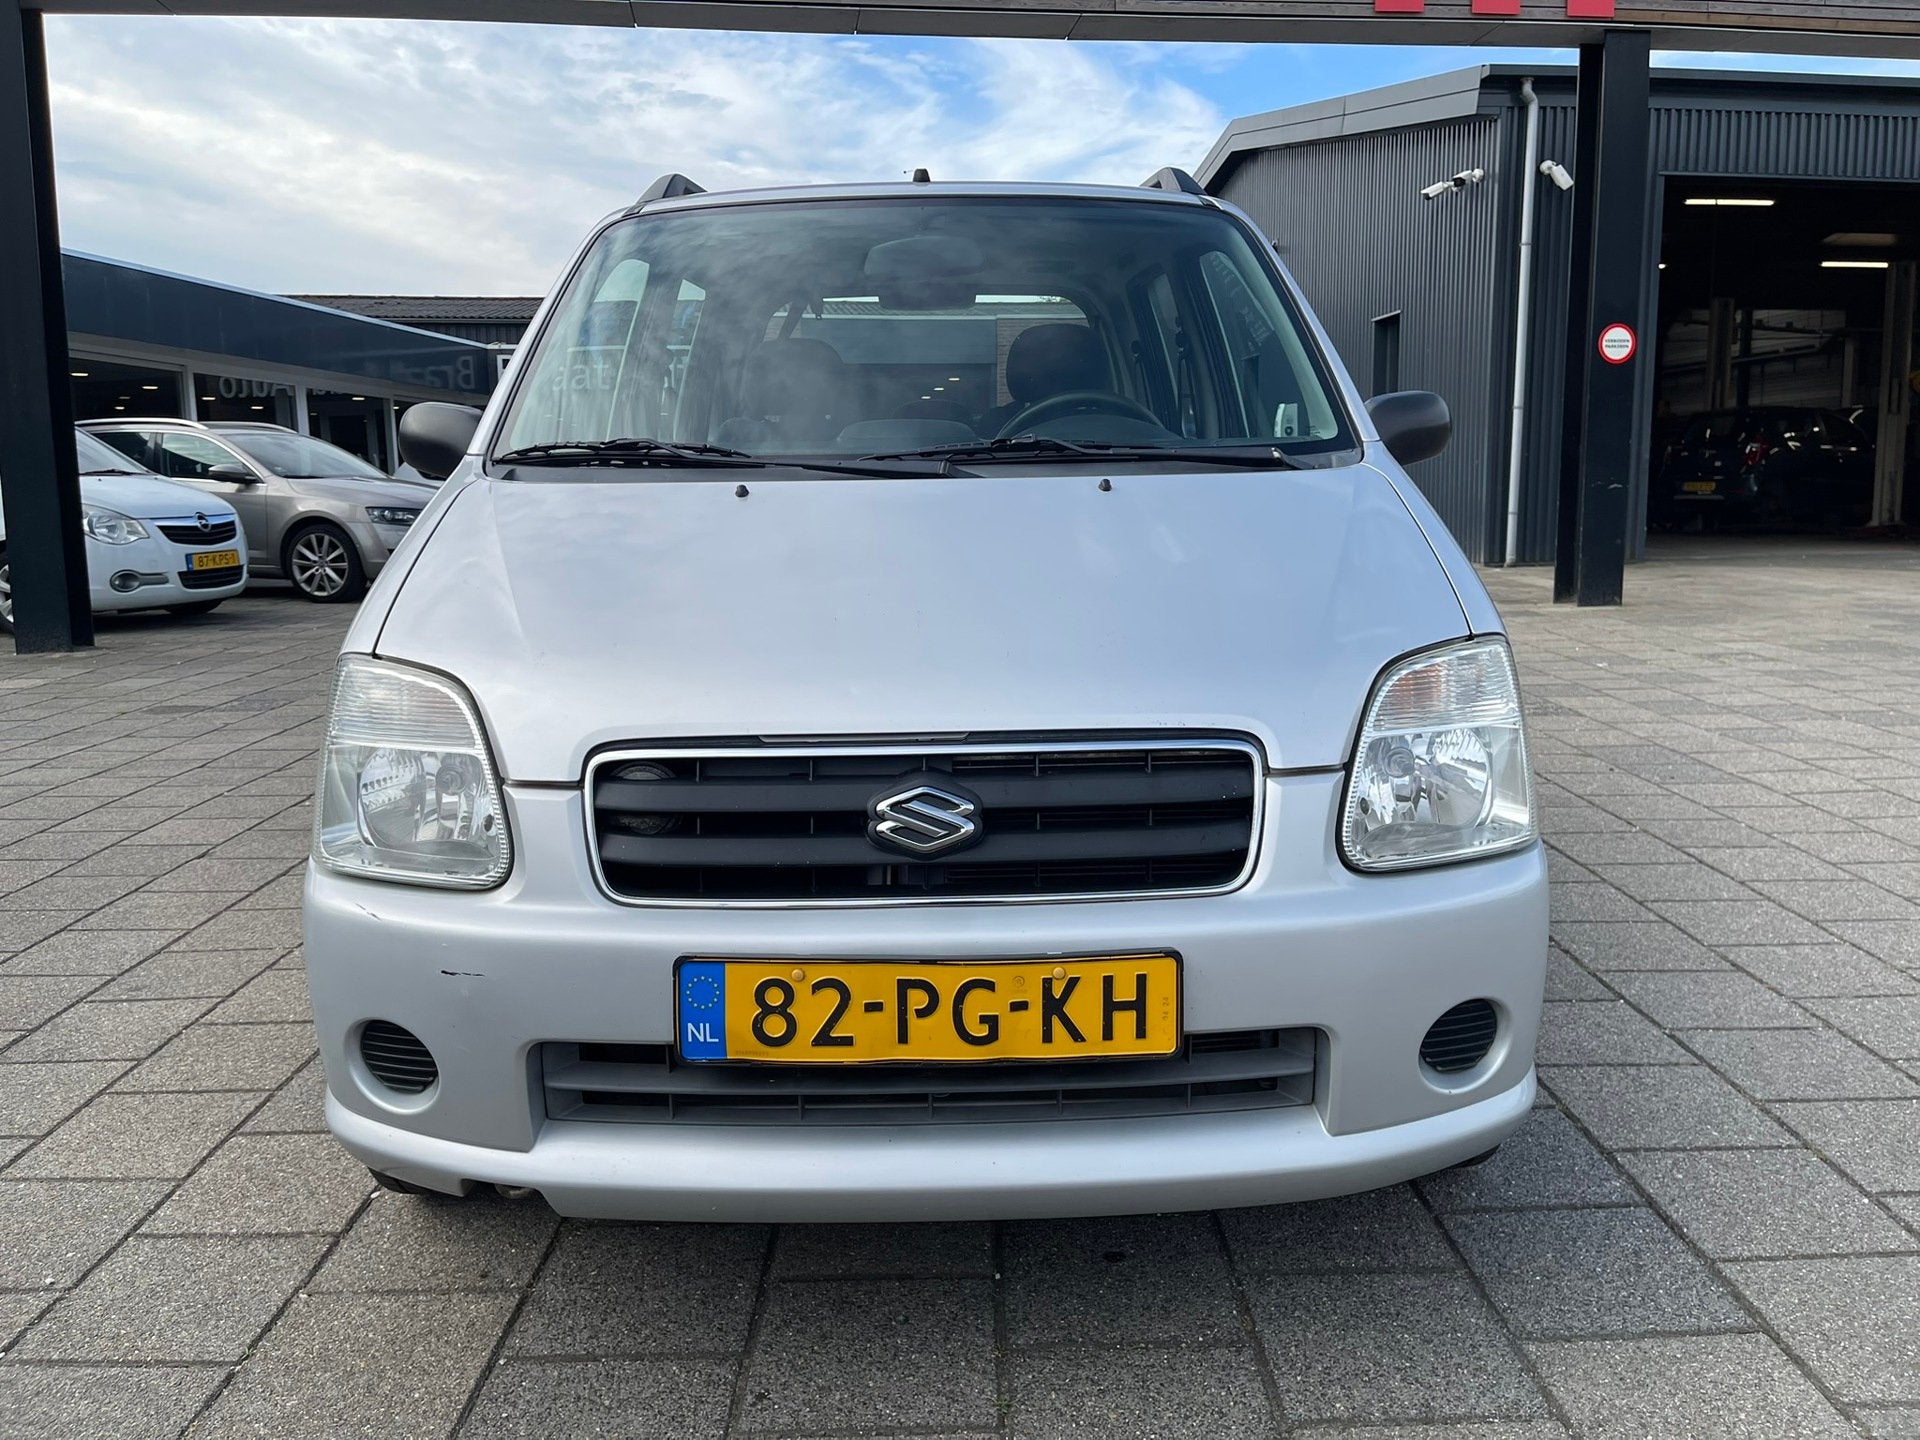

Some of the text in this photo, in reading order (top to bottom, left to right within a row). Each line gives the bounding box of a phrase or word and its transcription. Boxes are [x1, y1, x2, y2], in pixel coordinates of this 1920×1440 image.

[198, 552, 236, 568] 87-KPS-1
[751, 972, 1147, 1047] 82-PG-KH
[687, 1022, 719, 1042] NL
